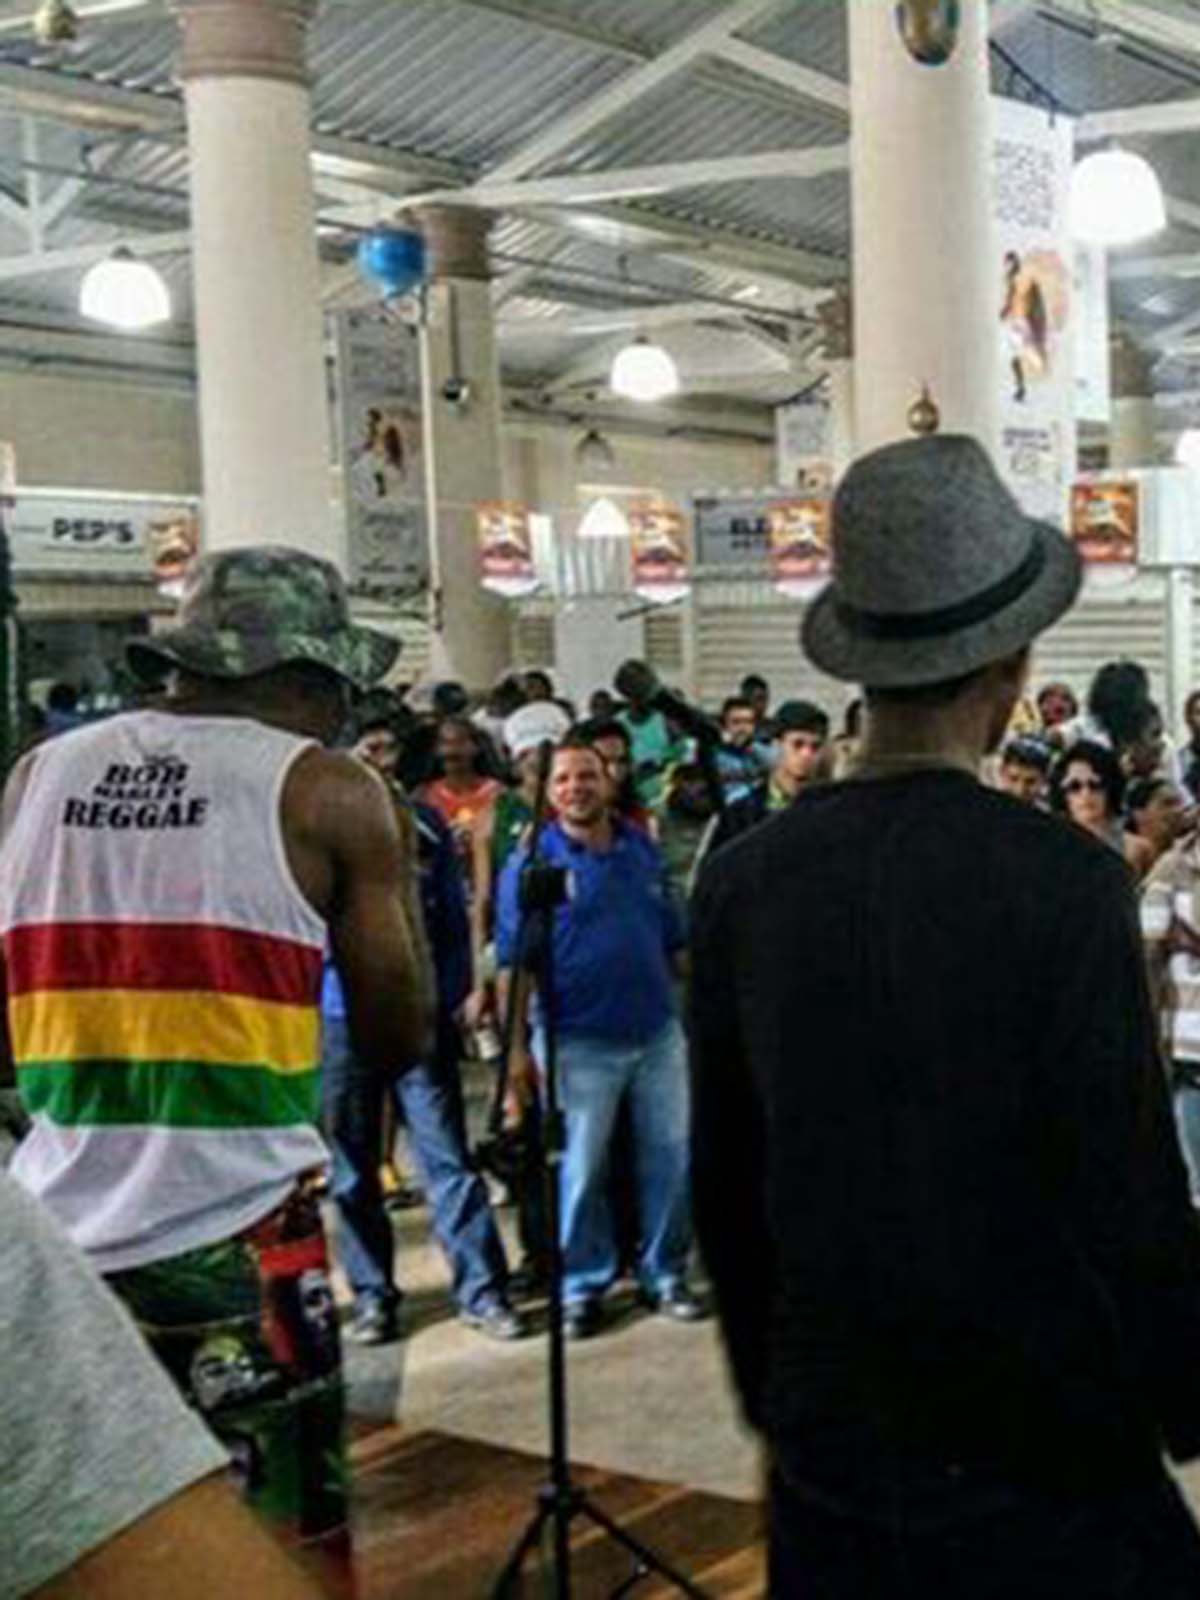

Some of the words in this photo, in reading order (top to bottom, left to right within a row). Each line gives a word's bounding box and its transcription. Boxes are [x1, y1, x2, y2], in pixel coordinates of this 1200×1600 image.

[52, 517, 134, 544] PEP'S
[104, 762, 189, 785] BOB
[63, 796, 209, 830] REGGAE
